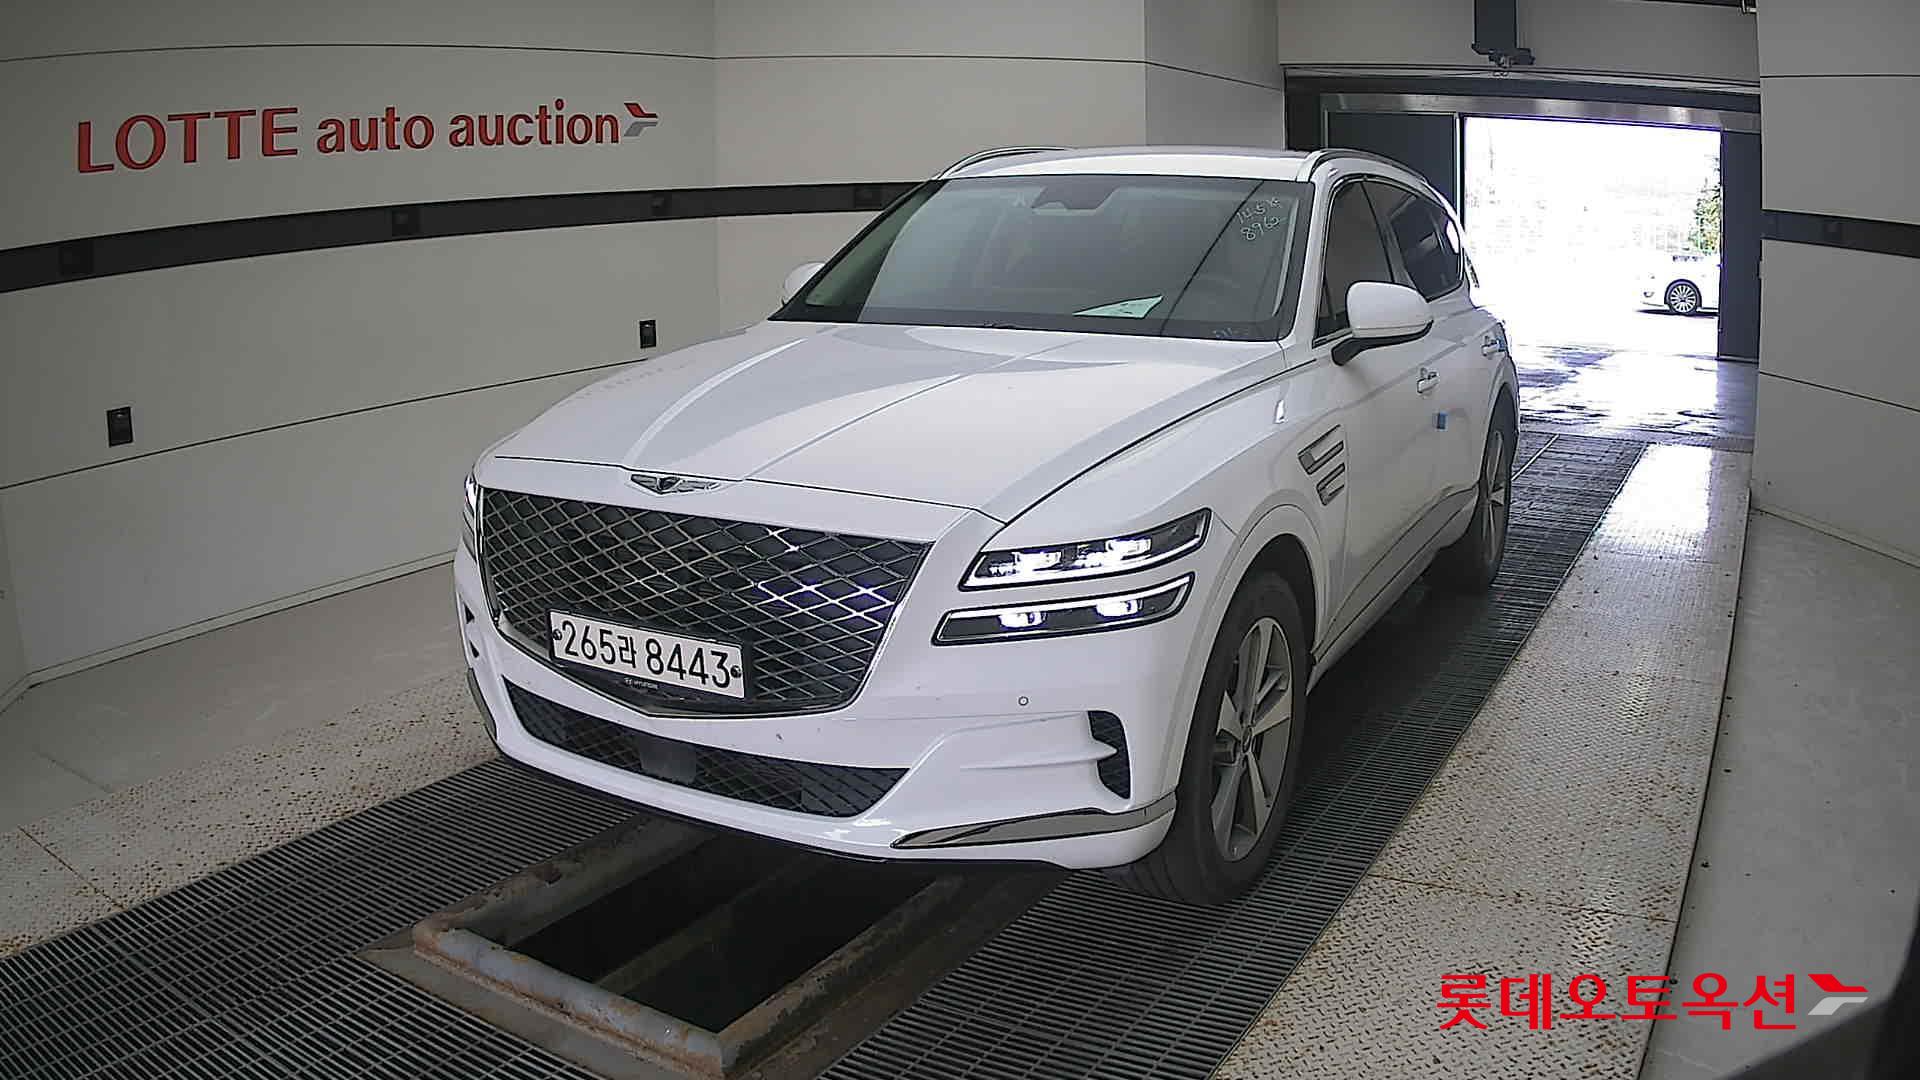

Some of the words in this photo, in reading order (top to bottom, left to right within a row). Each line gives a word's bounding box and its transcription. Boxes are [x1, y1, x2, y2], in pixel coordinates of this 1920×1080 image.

[77, 107, 299, 173] LOTTE
[316, 106, 434, 154] auto
[449, 98, 620, 147] auction
[562, 620, 637, 669] 265라
[645, 638, 730, 689] 8443
